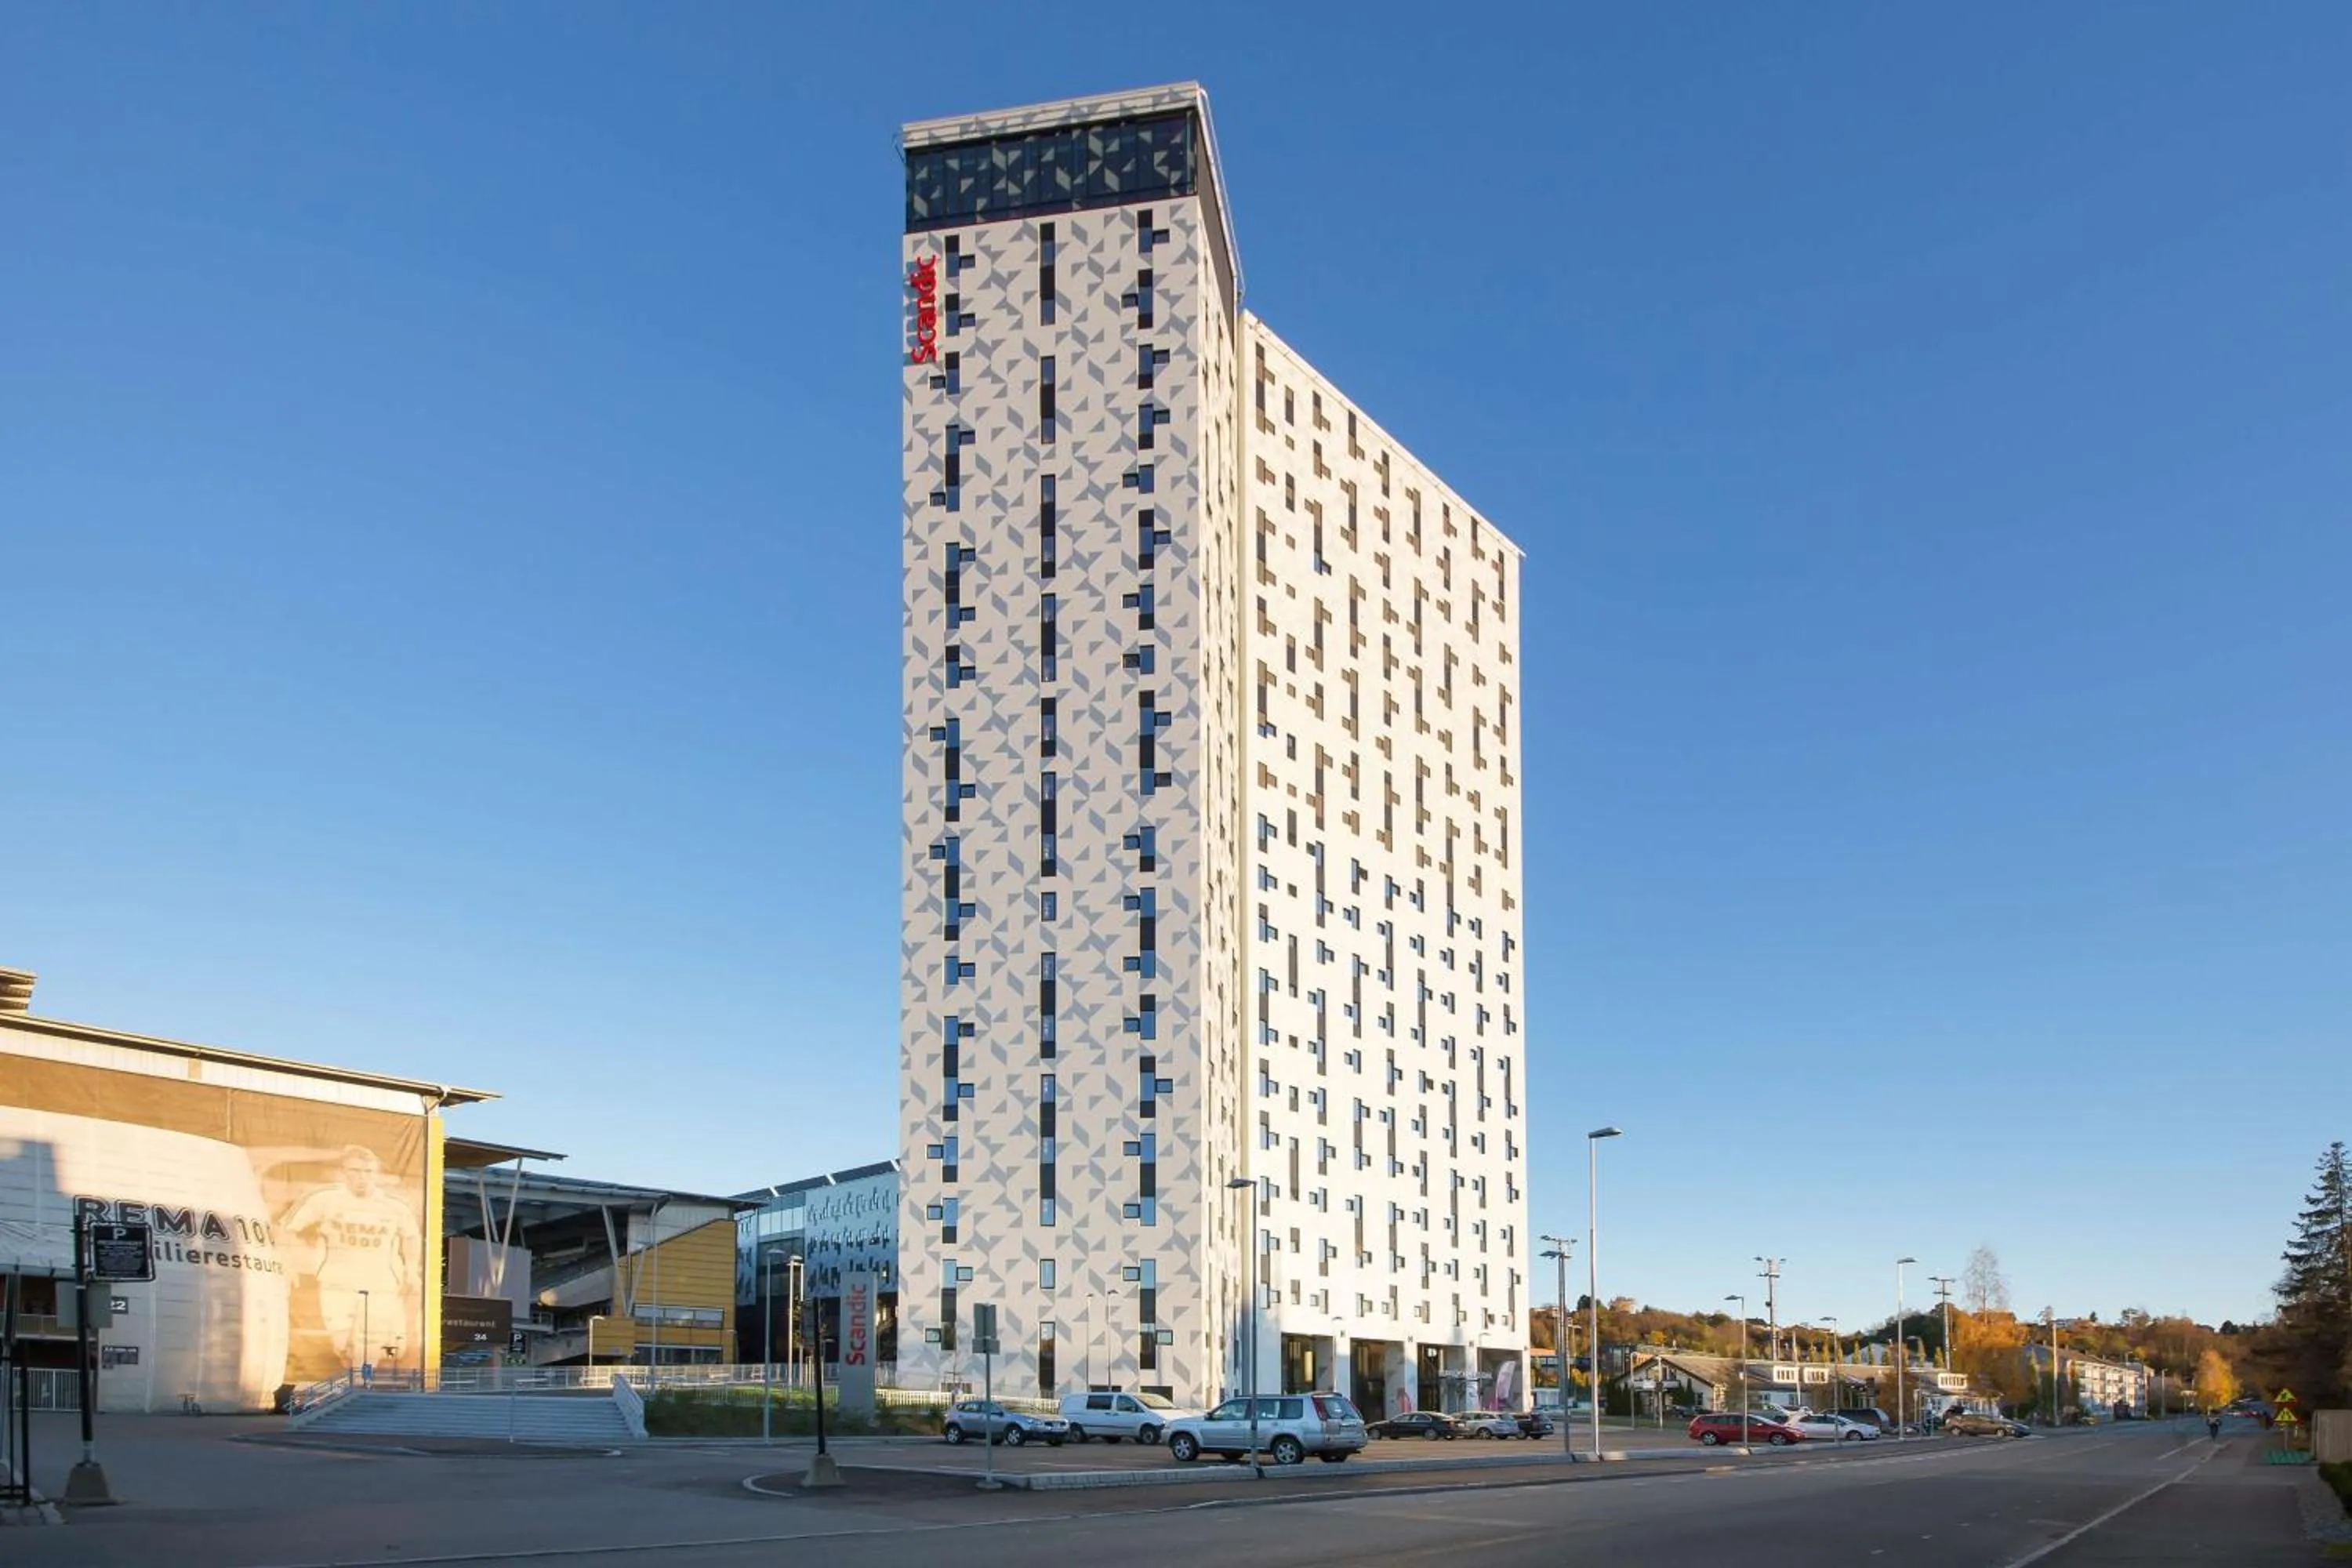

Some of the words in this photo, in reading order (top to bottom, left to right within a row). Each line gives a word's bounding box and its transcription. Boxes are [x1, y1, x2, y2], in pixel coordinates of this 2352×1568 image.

[910, 255, 937, 364] Scandic
[74, 1195, 230, 1242] REMA
[114, 1228, 126, 1239] P
[845, 1283, 866, 1365] Scandic
